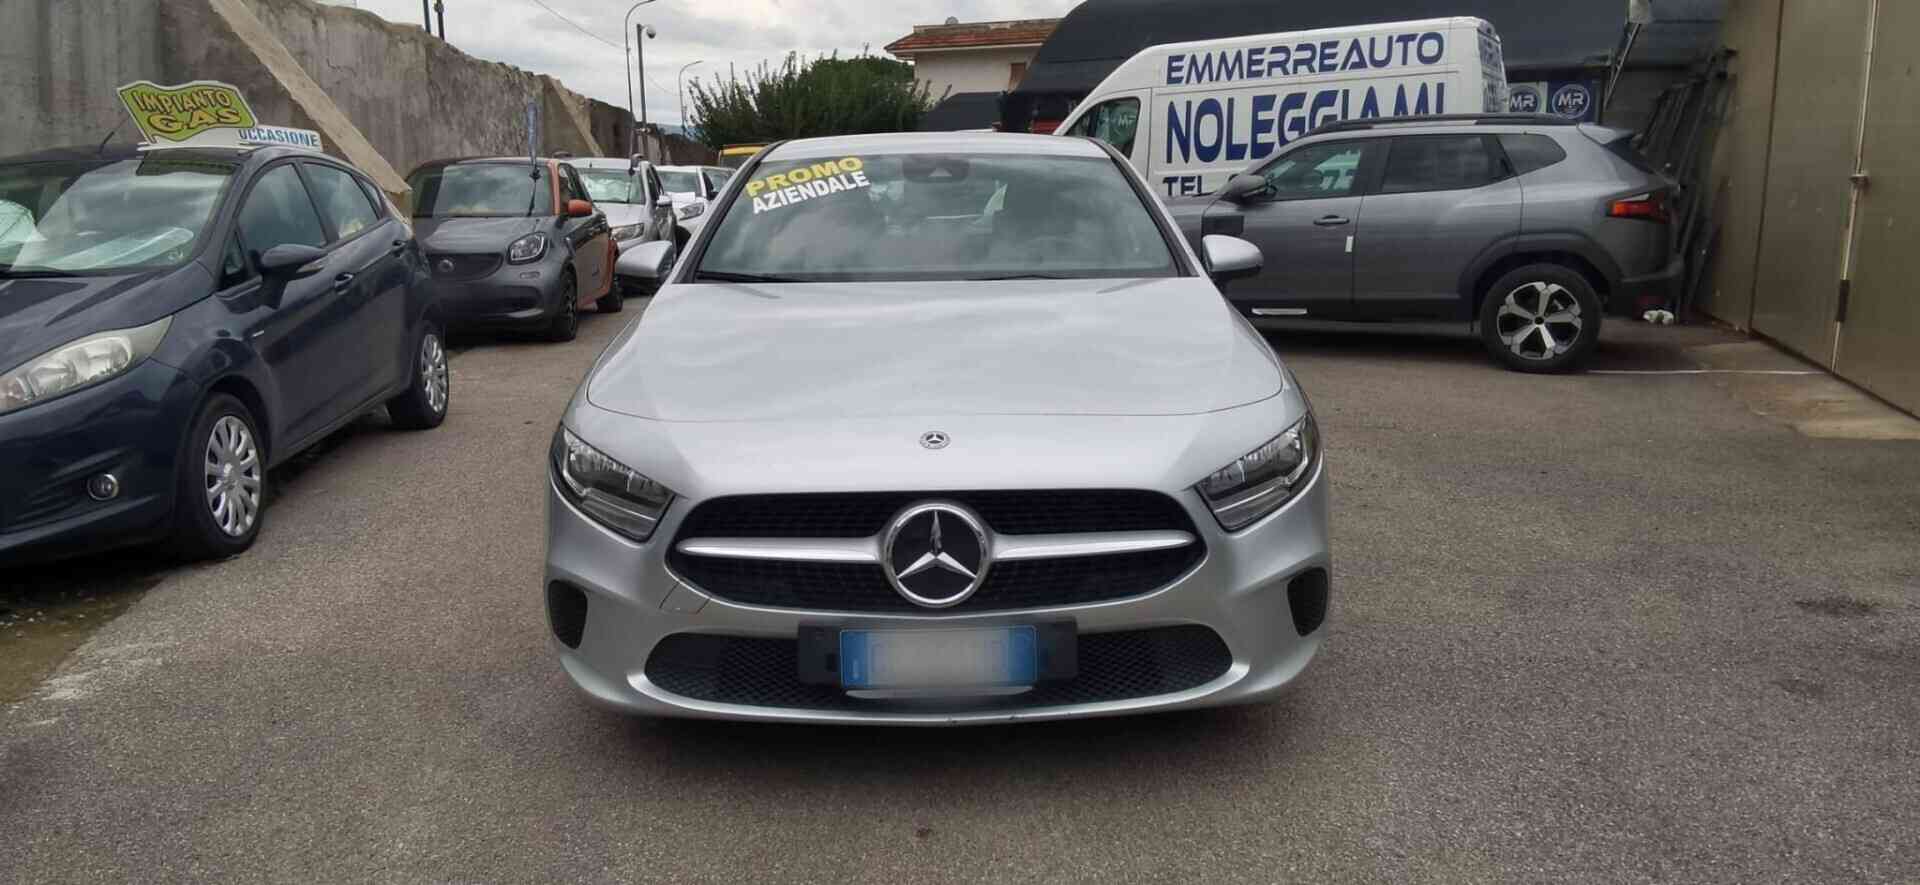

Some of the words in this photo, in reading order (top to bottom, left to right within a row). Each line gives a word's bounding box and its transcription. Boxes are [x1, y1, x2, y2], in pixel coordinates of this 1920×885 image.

[1166, 31, 1445, 85] EMMERREAUTO
[131, 88, 233, 114] IMPIANTO
[1510, 94, 1535, 109] MR
[1558, 92, 1584, 107] MR
[148, 108, 242, 133] GAS
[238, 127, 321, 148] OCCASIONE
[745, 156, 864, 197] PROMO
[752, 170, 870, 215] AZIENDALE
